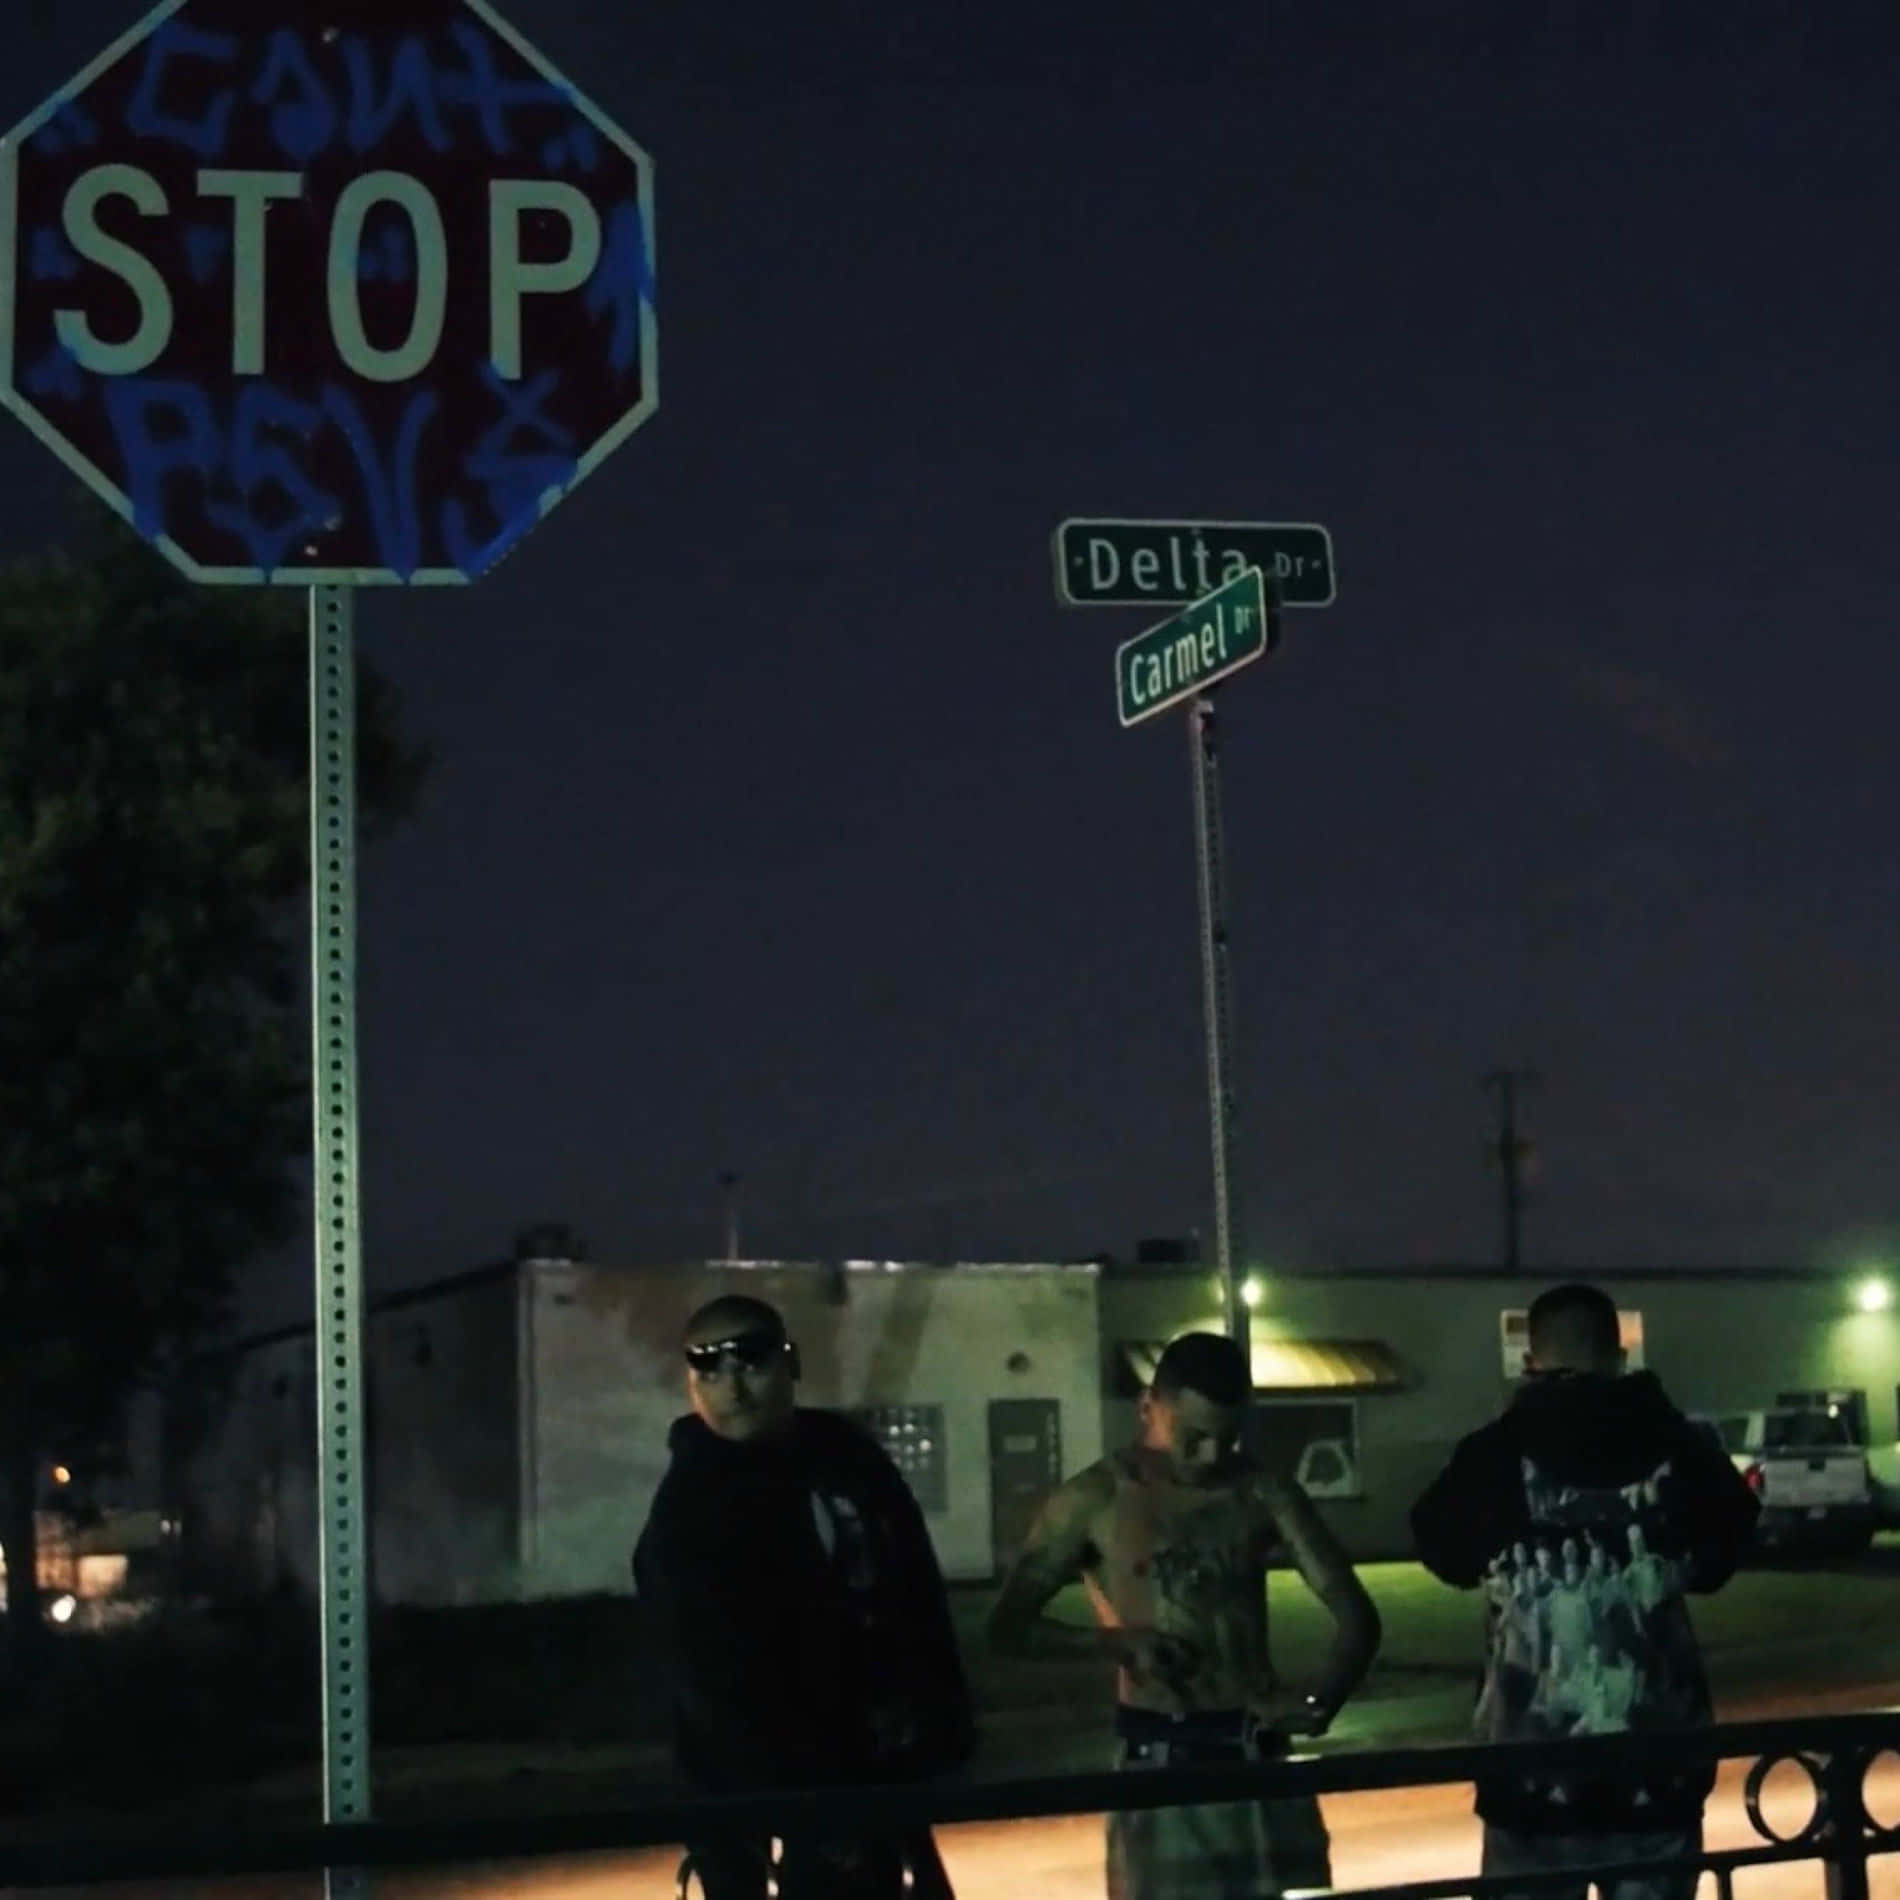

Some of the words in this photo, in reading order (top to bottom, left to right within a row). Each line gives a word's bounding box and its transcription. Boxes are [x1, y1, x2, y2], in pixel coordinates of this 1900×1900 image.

[53, 163, 602, 382] STOP
[1089, 536, 1248, 592] Delta
[1274, 551, 1304, 578] Dr
[1130, 602, 1227, 706] Carmel
